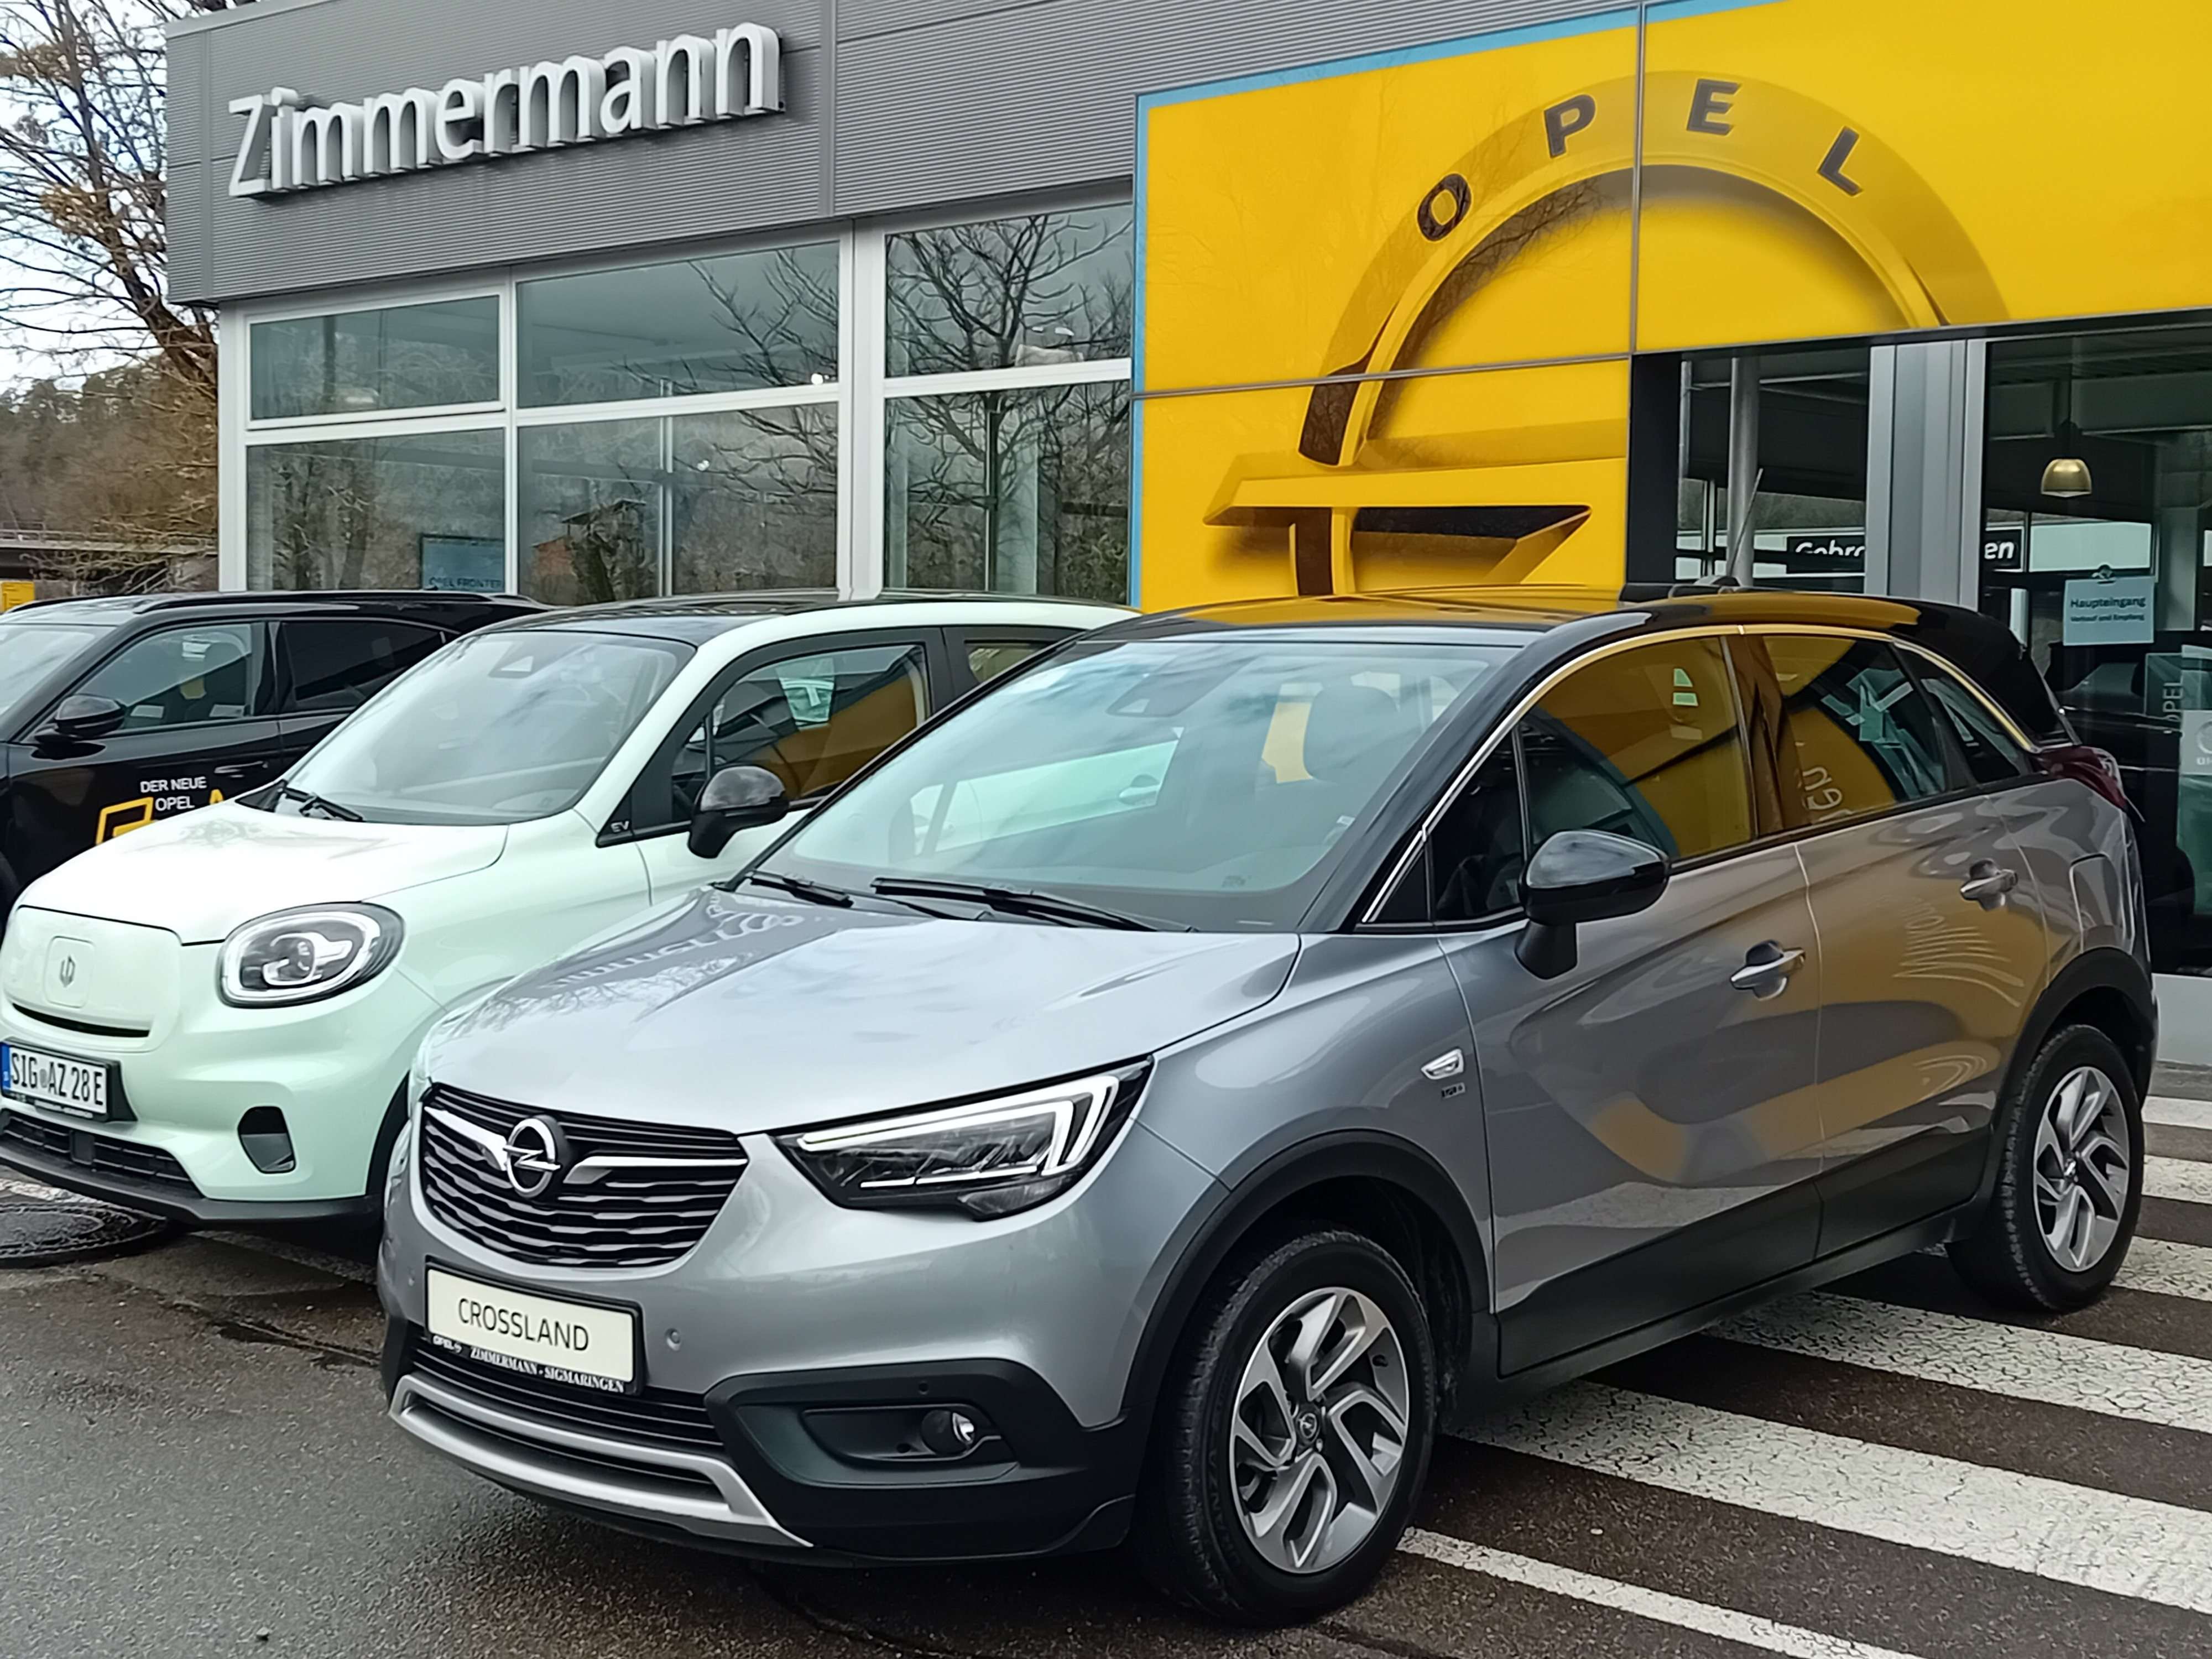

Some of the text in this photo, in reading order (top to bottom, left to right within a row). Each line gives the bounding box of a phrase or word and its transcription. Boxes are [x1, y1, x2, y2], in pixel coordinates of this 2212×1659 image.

[228, 22, 783, 196] Zimmermann
[1416, 77, 1864, 242] OPEL
[2070, 597, 2146, 608] Haupteingang
[140, 776, 207, 793] DER NEUE
[155, 796, 195, 811] OPEL
[610, 820, 629, 833] EV
[11, 1052, 38, 1088] SIG
[48, 1061, 67, 1097] AZ
[458, 1298, 589, 1351] CROSSLAND
[470, 1347, 538, 1376] ZIMMERMANN
[544, 1367, 625, 1393] SIGMARINGEN
